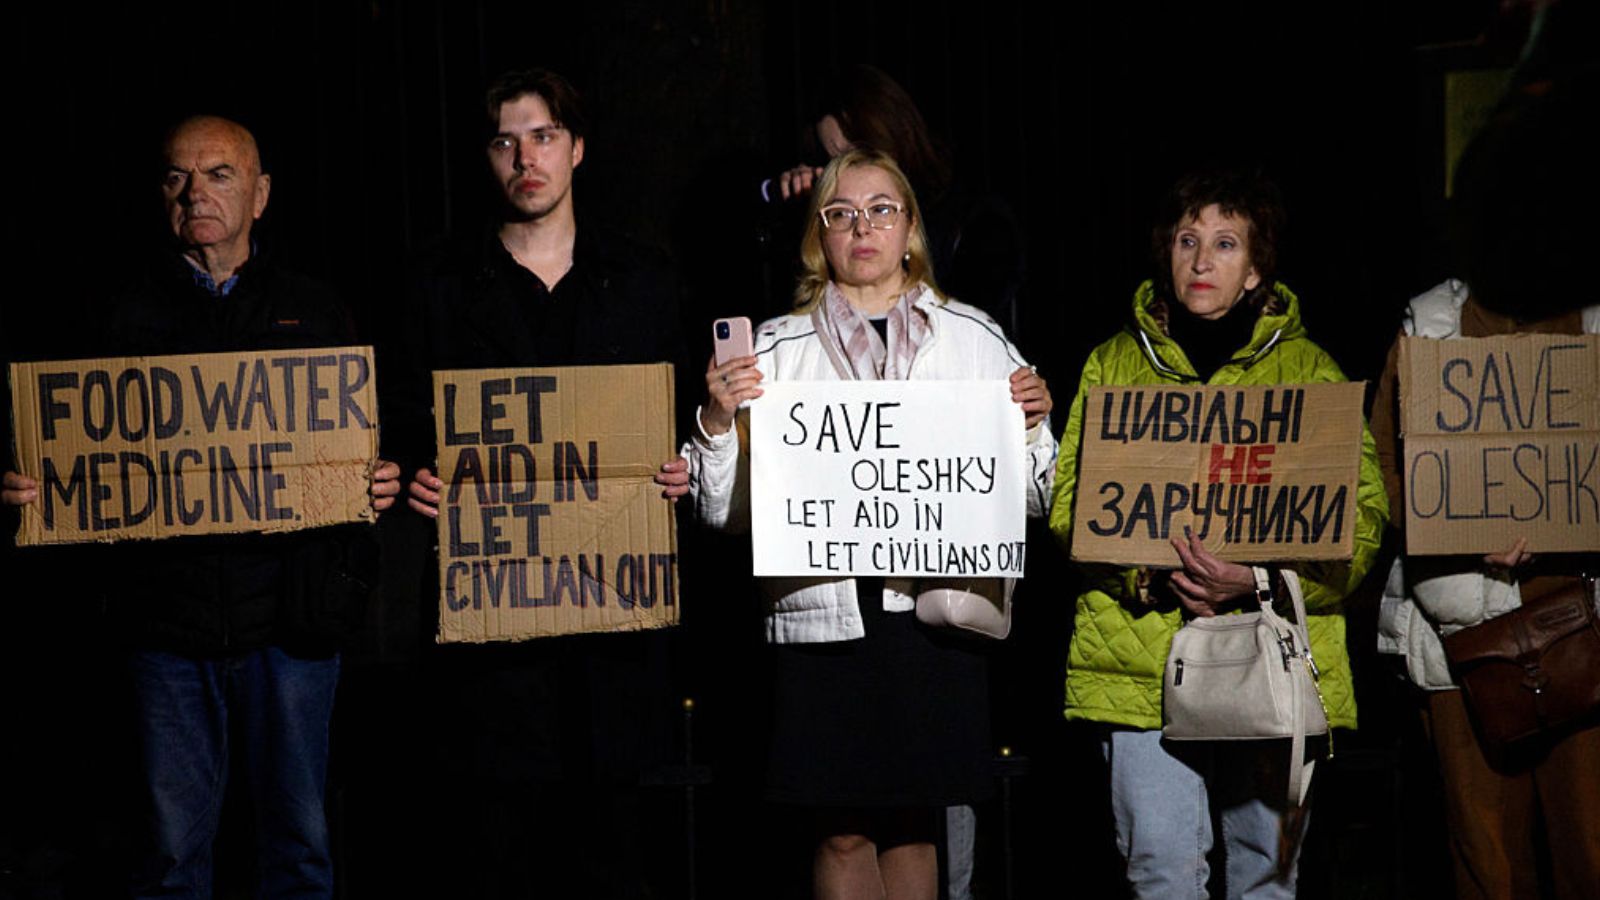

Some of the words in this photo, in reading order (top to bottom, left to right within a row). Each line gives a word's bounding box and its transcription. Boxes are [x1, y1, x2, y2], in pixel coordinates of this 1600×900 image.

[444, 376, 556, 446] LET
[1100, 389, 1304, 444] ЦИВІЛЬНІ
[1436, 345, 1587, 433] SAVE
[783, 401, 901, 453] SAVE
[42, 442, 301, 531] MEDICINE.
[447, 444, 537, 506] AID
[553, 440, 599, 502] IN
[851, 457, 996, 494] OLESHKY
[1208, 443, 1276, 484] НЕ
[447, 503, 551, 557] LET
[787, 498, 835, 527] LET
[1087, 481, 1347, 544] ЗАРУЧНИКИ
[446, 554, 606, 611] CIVILIAN
[616, 553, 676, 610] OUT
[808, 540, 860, 572] LET
[997, 541, 1026, 572] OUT
